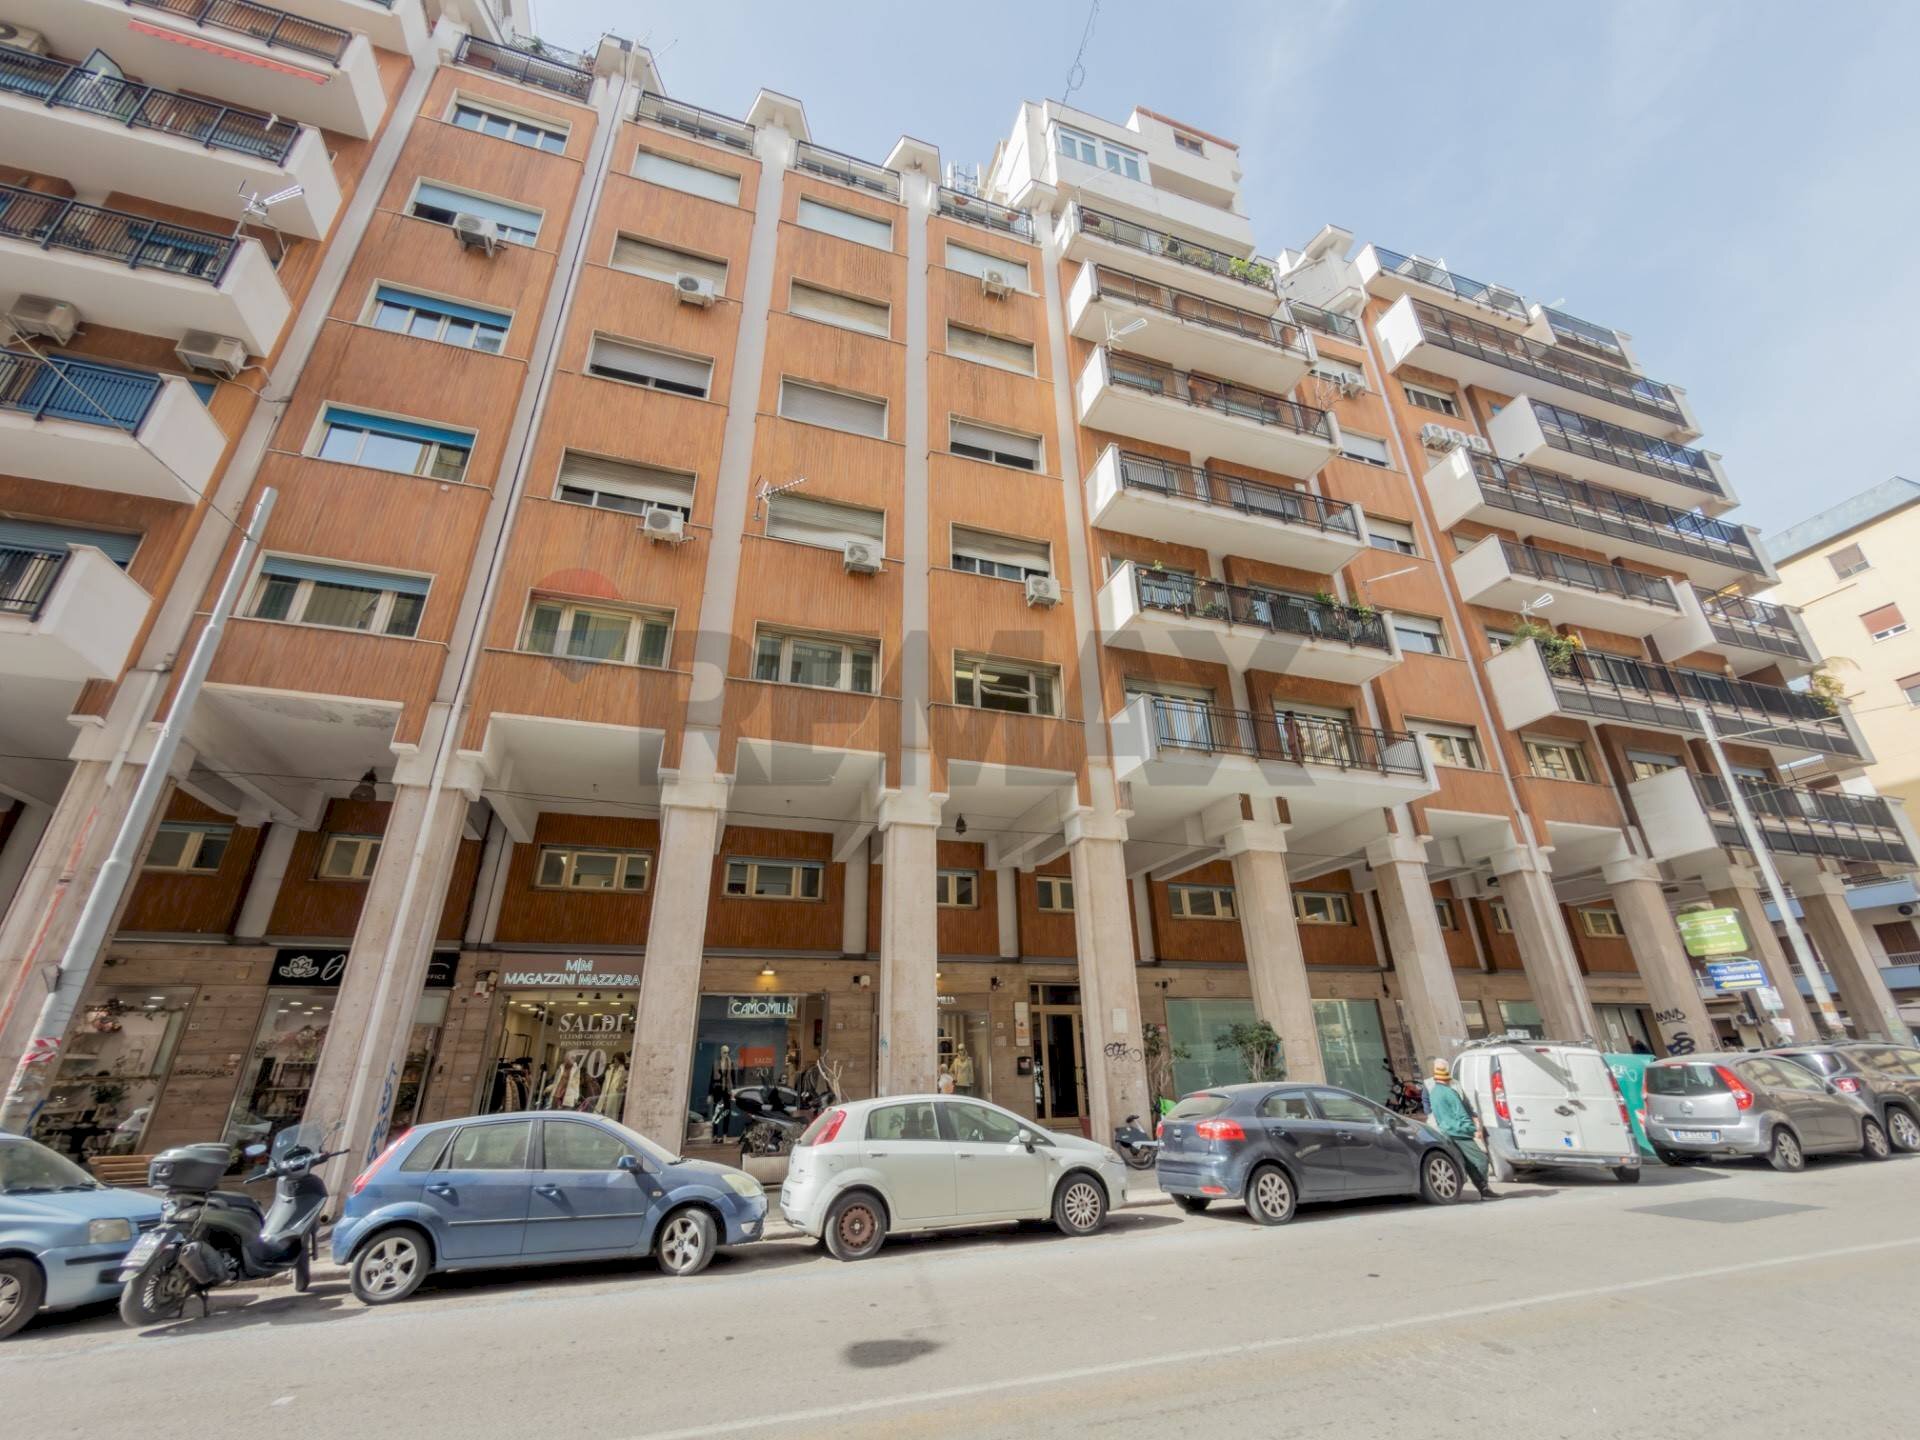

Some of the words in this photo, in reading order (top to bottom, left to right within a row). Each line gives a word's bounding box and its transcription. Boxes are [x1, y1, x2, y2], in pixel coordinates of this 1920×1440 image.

[504, 972, 576, 985] MAGAZZINI
[578, 973, 641, 986] MAZZARA
[731, 1002, 794, 1015] CAMOMILLA
[558, 1013, 625, 1033] SALDI
